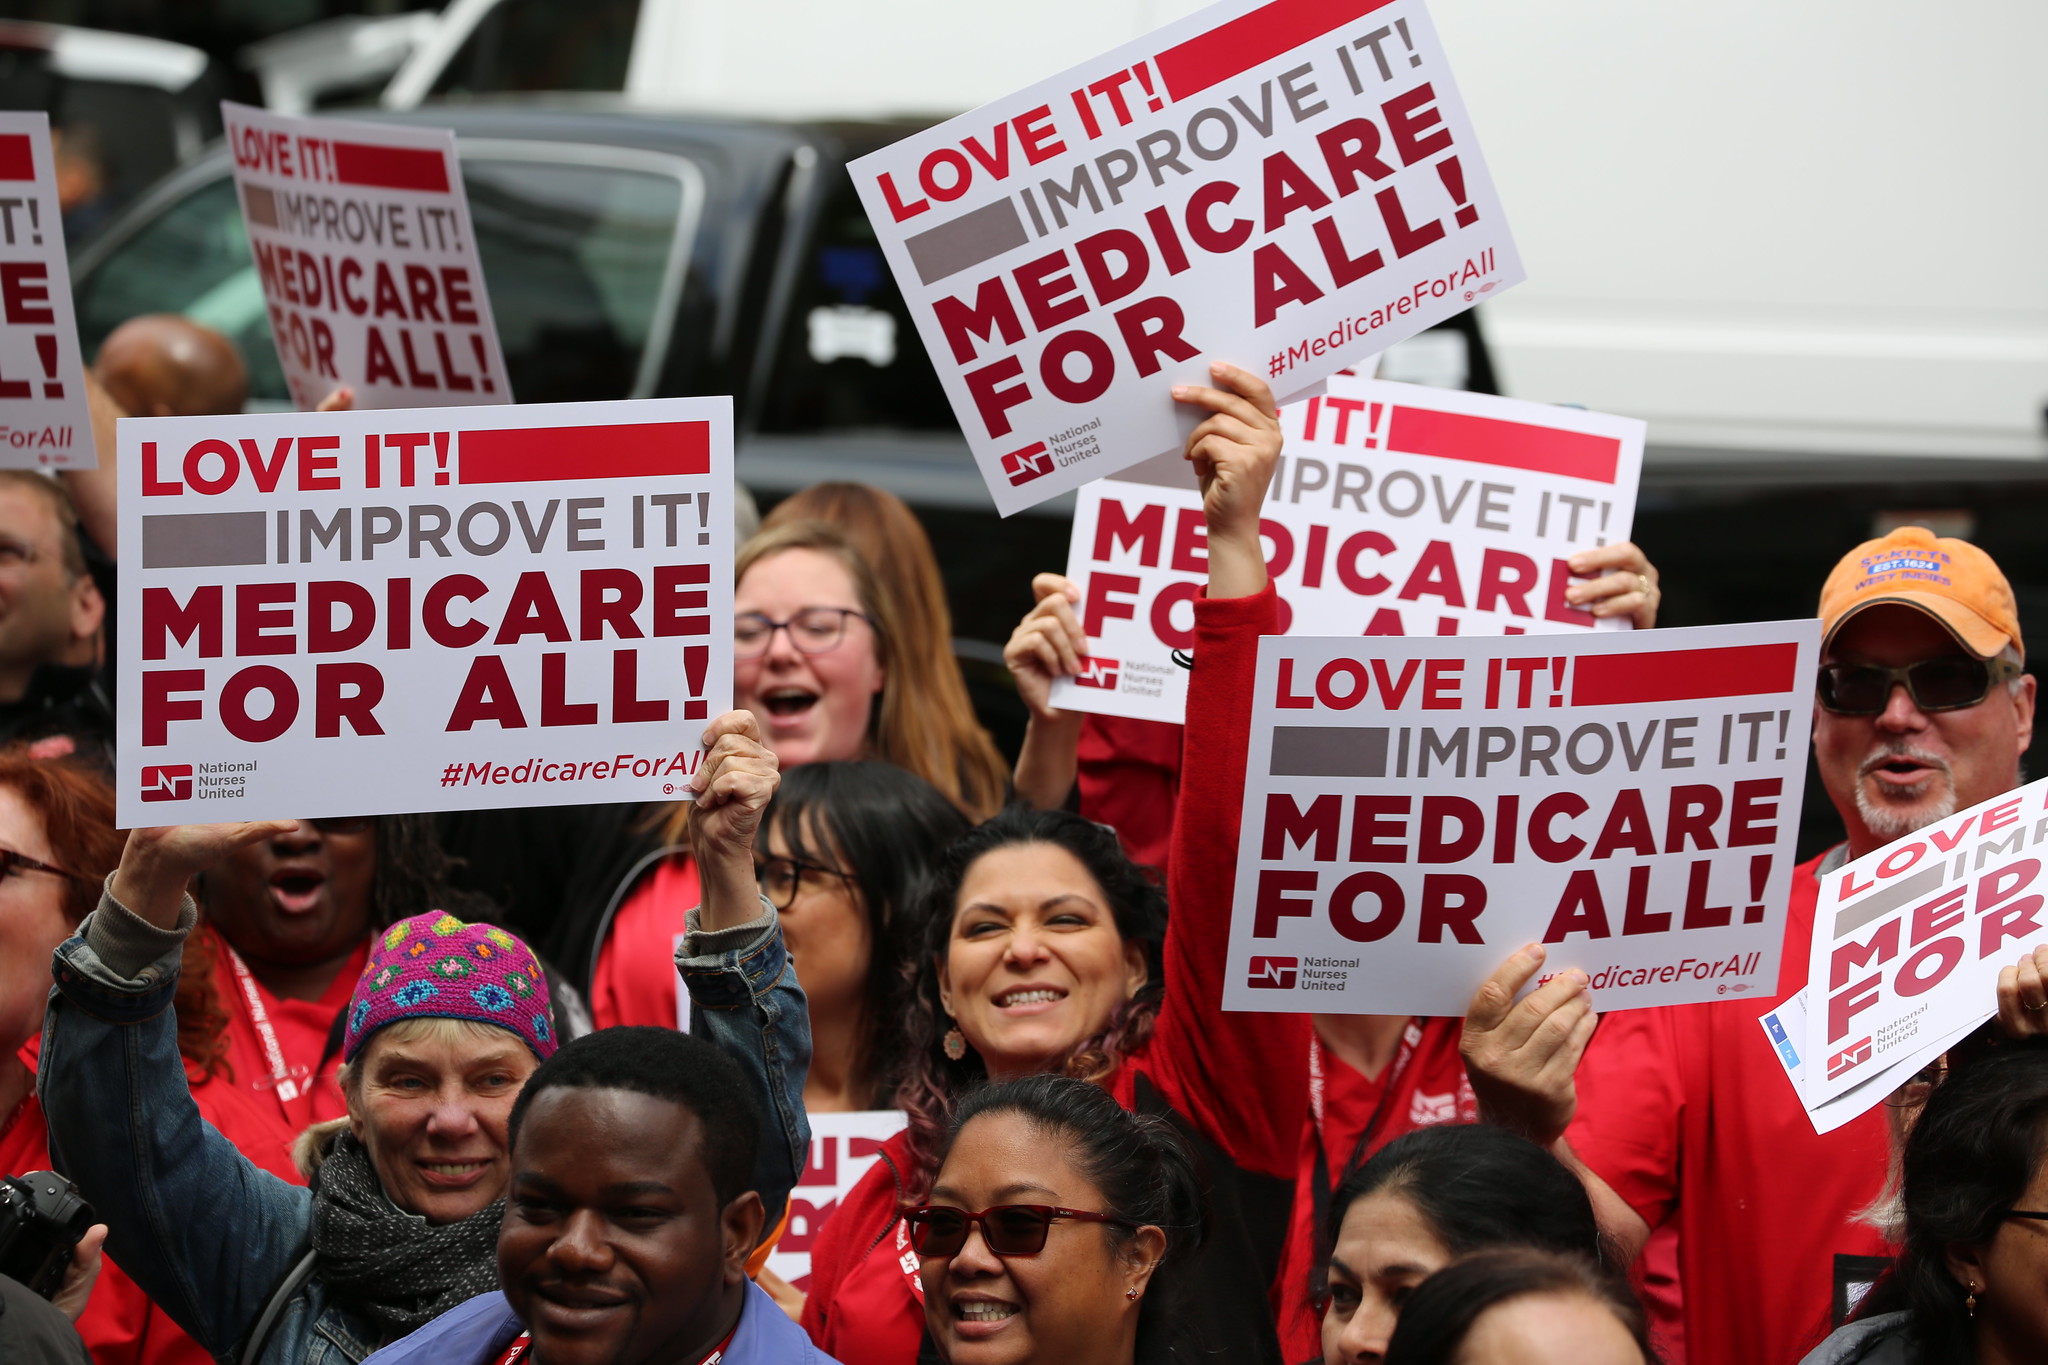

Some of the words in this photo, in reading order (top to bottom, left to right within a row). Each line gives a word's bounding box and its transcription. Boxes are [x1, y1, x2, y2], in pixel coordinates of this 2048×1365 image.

[231, 123, 293, 177] LOVE
[297, 136, 335, 184] IT!
[876, 104, 1067, 224] LOVE
[1071, 61, 1165, 140] IT!
[1018, 62, 1330, 237] IMPROVE
[1336, 17, 1423, 97] IT!
[0, 198, 43, 245] T!
[278, 190, 410, 248] IMPROVE
[418, 206, 463, 252] IT!
[931, 81, 1454, 365] MEDICARE
[253, 238, 479, 325] MEDICARE
[964, 295, 1203, 440] FOR
[1252, 155, 1479, 329] ALL!
[1268, 247, 1495, 378] #MedicareForAll
[270, 304, 339, 381] FOR
[365, 325, 496, 394] ALL!
[1049, 417, 1102, 446] National
[1054, 435, 1097, 456] Nurses
[1303, 396, 1384, 449] IT!
[141, 436, 341, 497] LOVE
[365, 431, 451, 489] IT!
[1059, 444, 1101, 468] United
[277, 497, 606, 565] IMPROVE
[632, 492, 711, 549] IT!
[1271, 456, 1515, 531] PROVE
[1535, 490, 1614, 546] IT!
[141, 563, 711, 660] MEDICARE
[1855, 573, 1896, 591] WEST
[1902, 572, 1952, 586] INDIES
[141, 661, 386, 747] FOR
[444, 645, 710, 733] ALL!
[1275, 657, 1465, 710] LOVE
[1484, 656, 1567, 710] IT!
[199, 760, 257, 774] National
[1396, 717, 1699, 778] IMPROVE
[1718, 710, 1791, 765] IT!
[198, 787, 244, 799] United
[199, 775, 246, 787] Nurses
[1261, 777, 1783, 864] MEDICARE
[1838, 797, 2023, 902] LOVE
[1253, 870, 1489, 945] FOR
[1541, 854, 1773, 944] ALL!
[1301, 981, 1345, 991] United
[1302, 969, 1347, 979] Nurses
[1304, 957, 1359, 968] National
[1535, 952, 1761, 990] #dicareForAll
[1828, 894, 2044, 1045] FOR
[1877, 1003, 1928, 1036] National
[1877, 1019, 1919, 1046] Nurses
[1877, 1026, 1918, 1054] United
